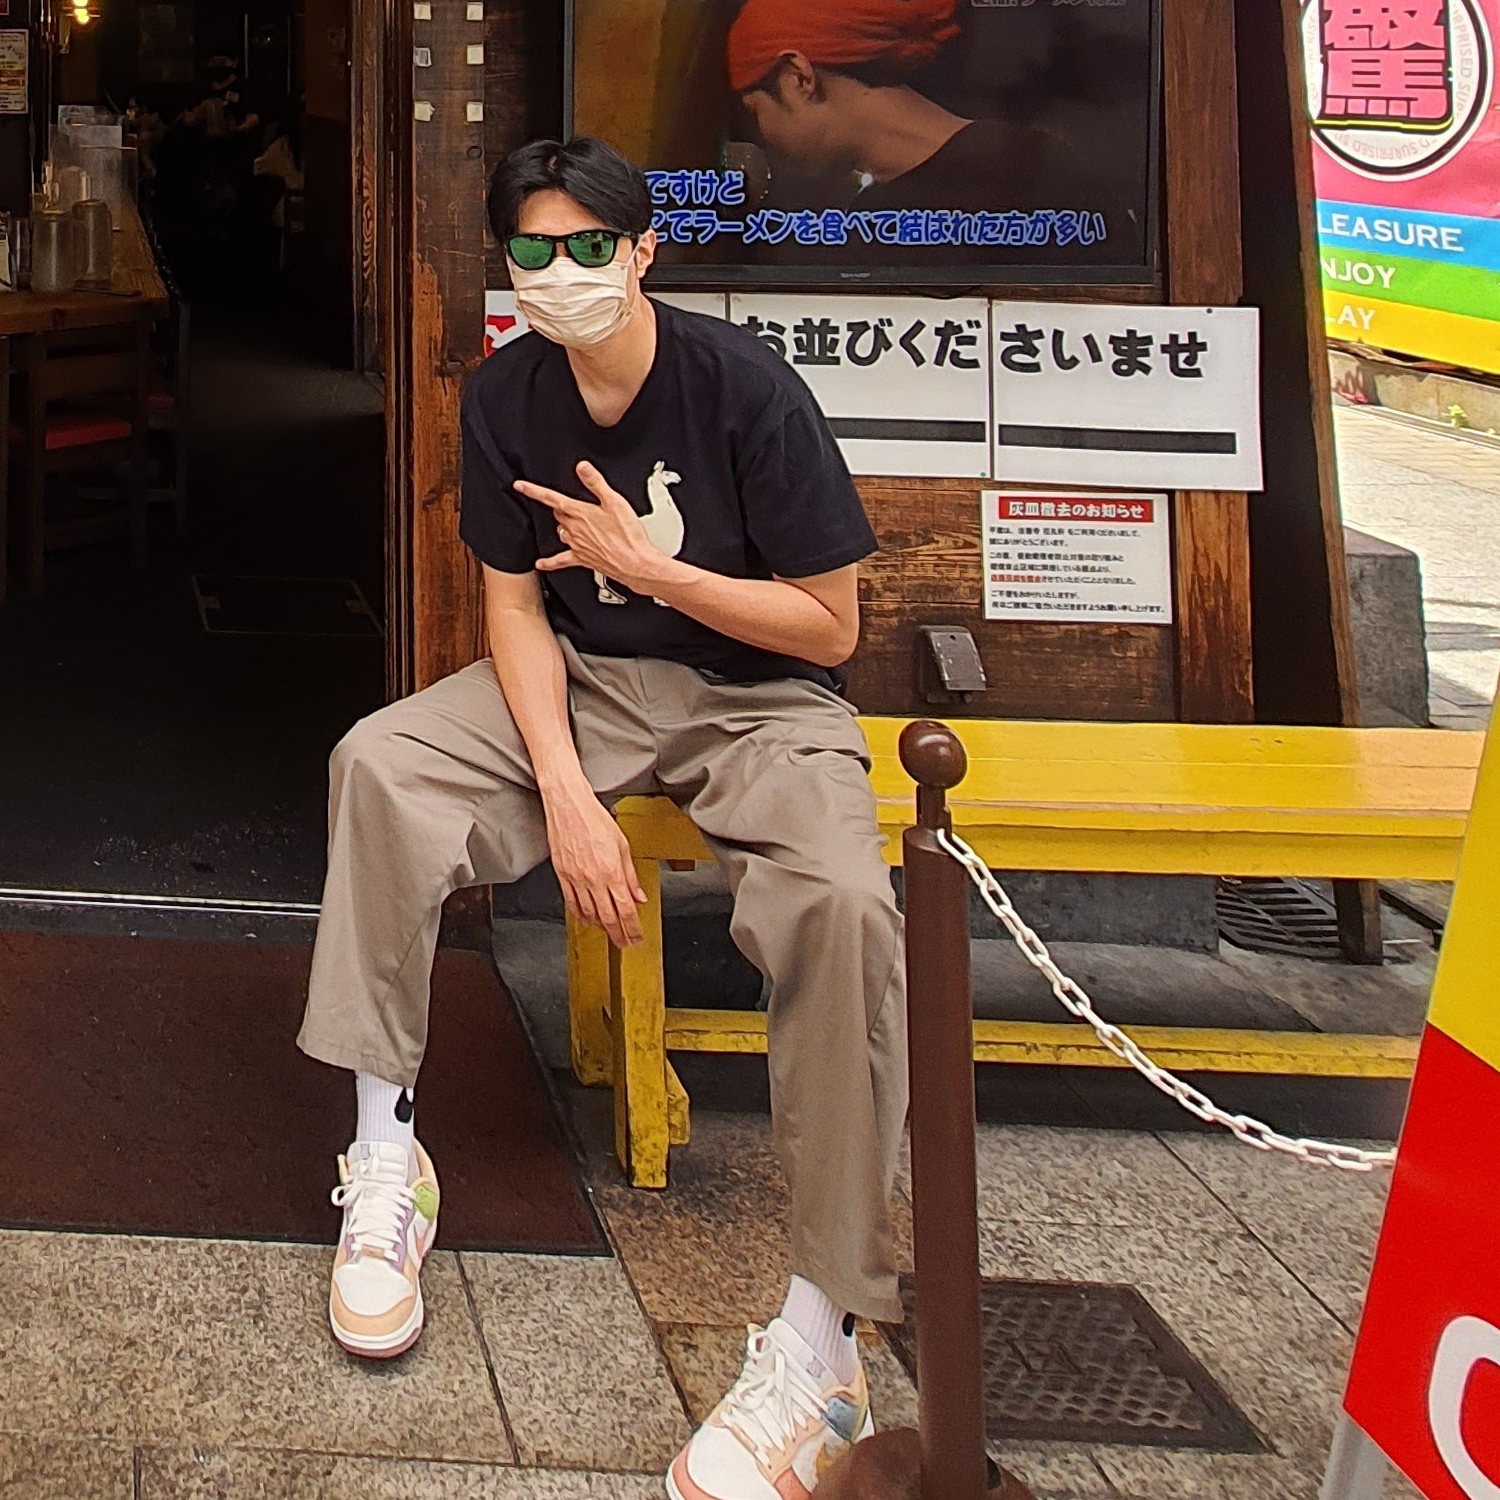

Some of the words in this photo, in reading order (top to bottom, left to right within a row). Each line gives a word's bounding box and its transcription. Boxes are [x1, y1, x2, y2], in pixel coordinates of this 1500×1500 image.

[1009, 502, 1145, 519] 灰皿撤去のお知らせ
